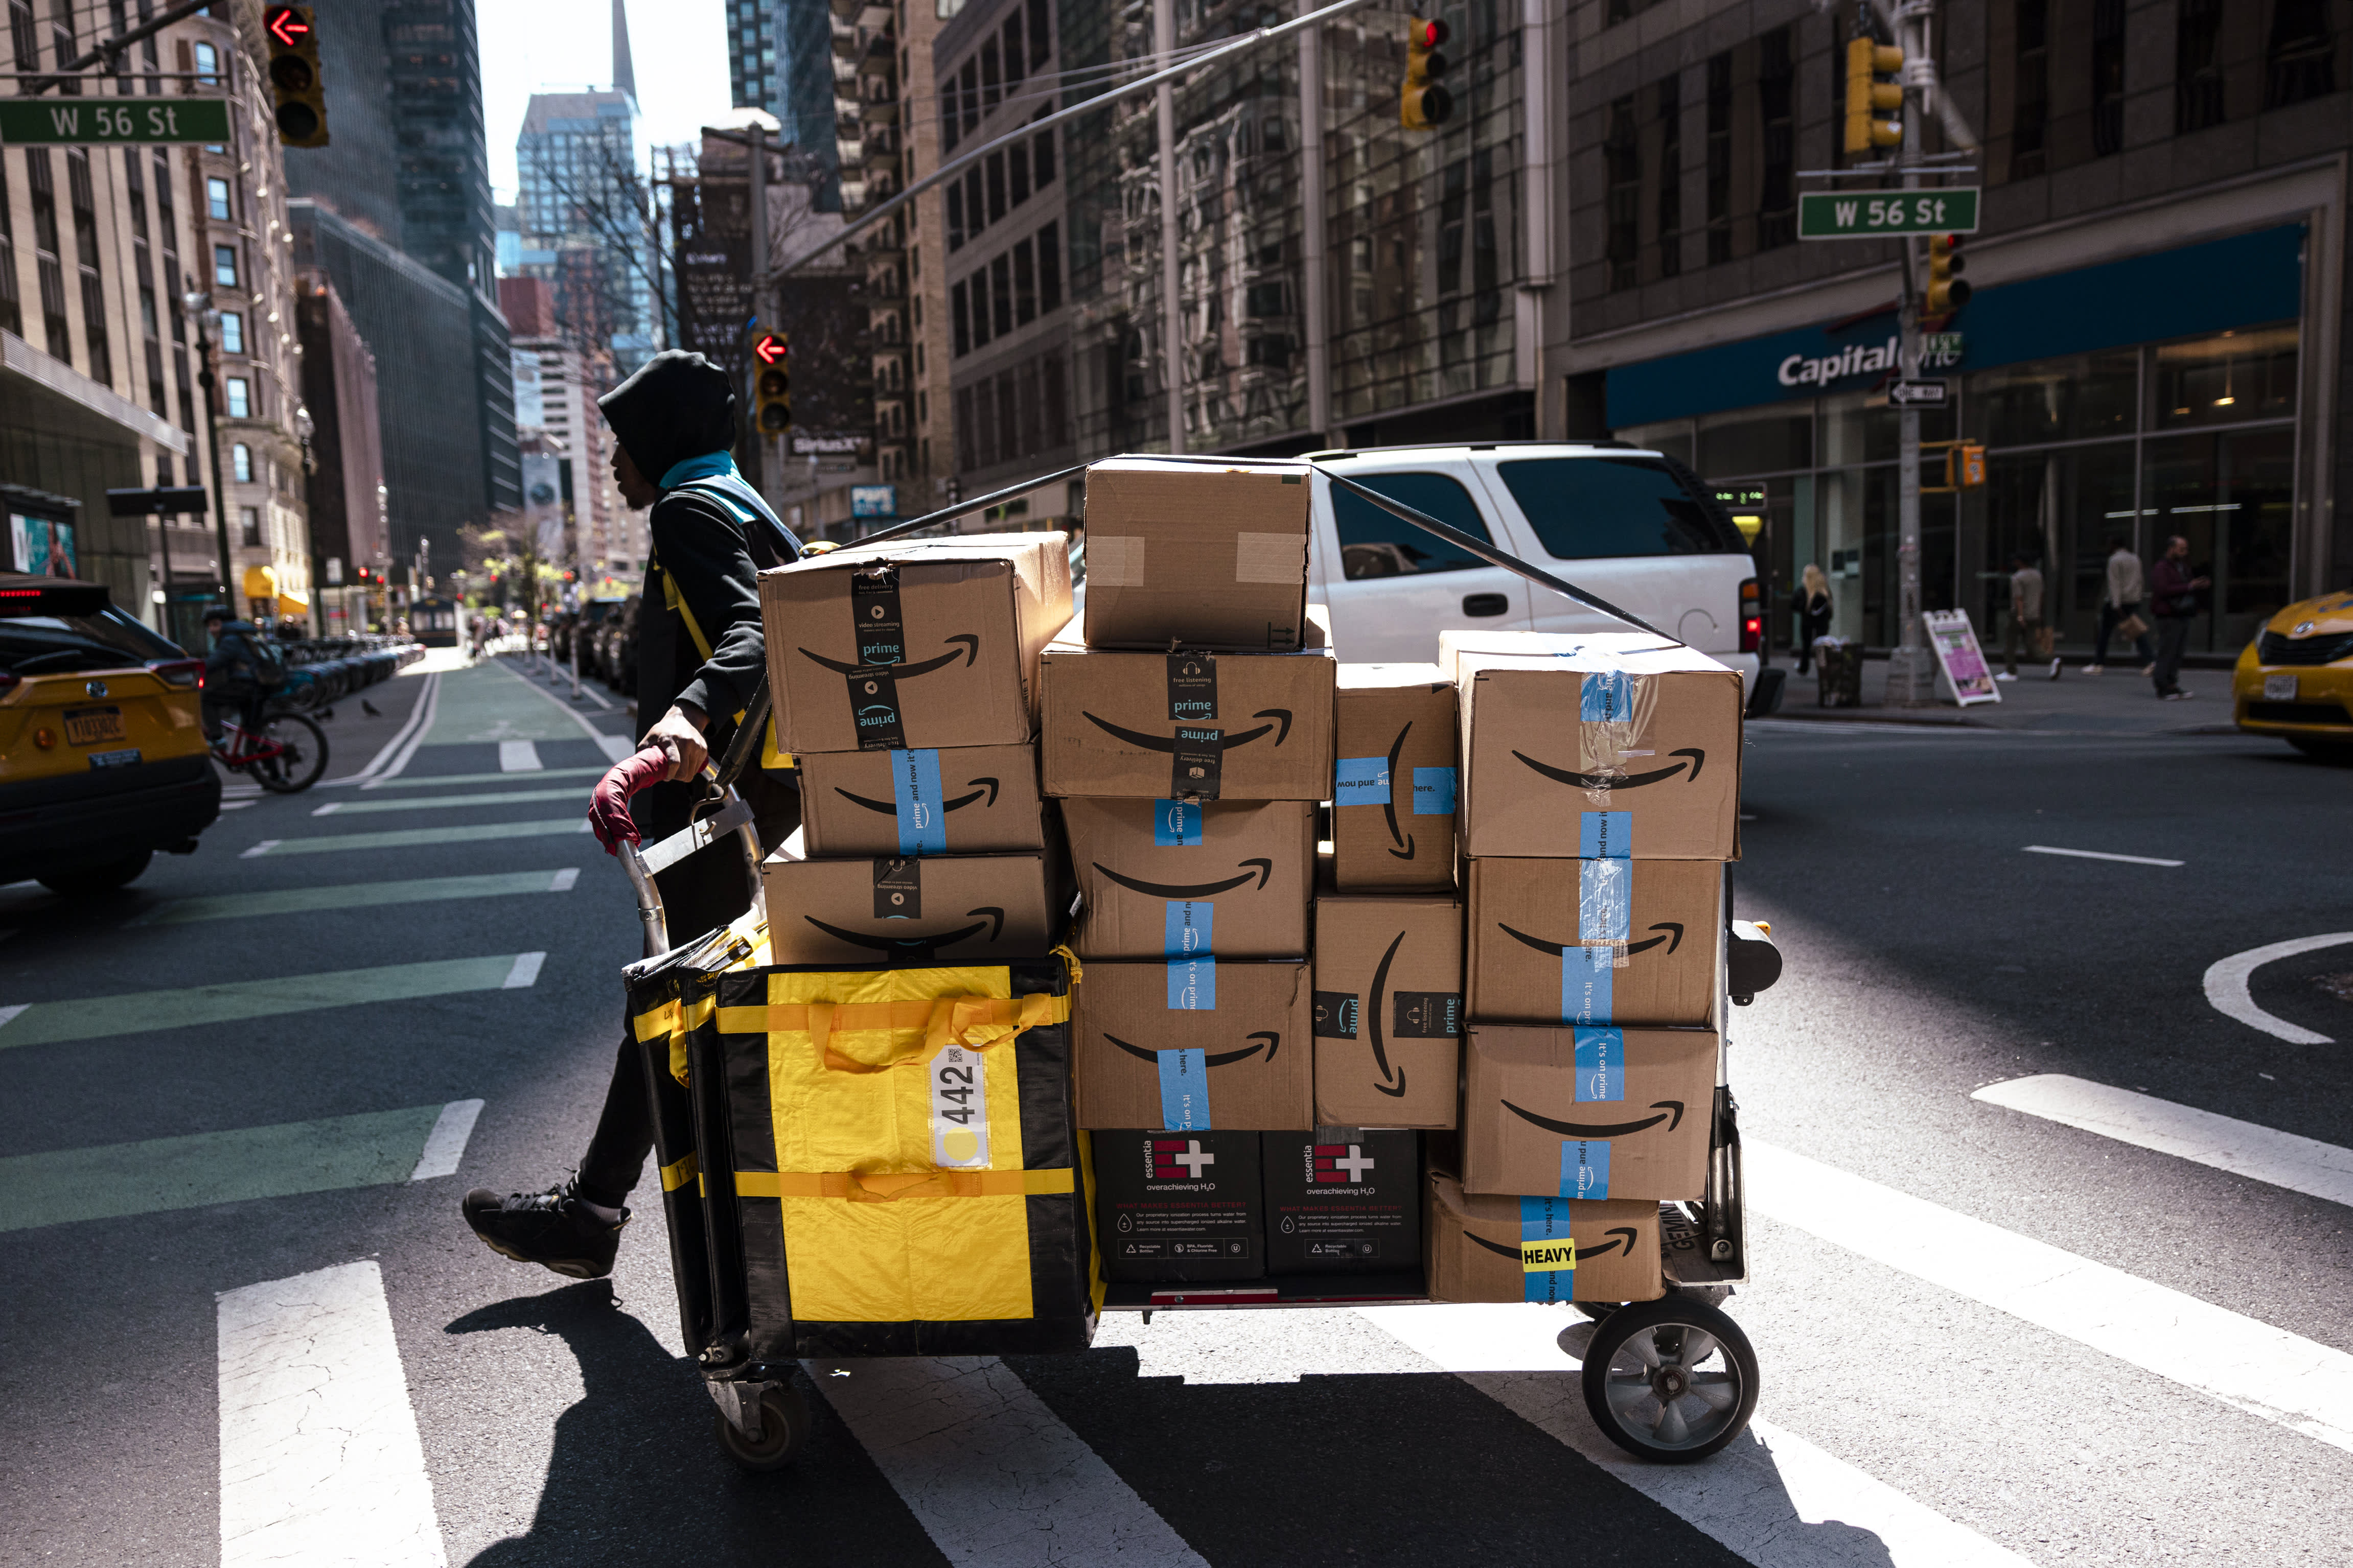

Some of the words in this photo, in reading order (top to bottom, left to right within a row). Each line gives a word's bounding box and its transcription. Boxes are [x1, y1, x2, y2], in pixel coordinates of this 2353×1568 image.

[52, 108, 78, 136] W
[96, 108, 133, 136] 56
[148, 107, 179, 136] St
[1835, 202, 1857, 227] W
[1867, 200, 1904, 225] 56
[1916, 198, 1946, 224] St
[1778, 337, 1898, 387] Capital
[864, 643, 899, 657] prime
[1175, 699, 1211, 713] prime
[1605, 693, 1613, 711] and
[860, 712, 895, 727] prime
[1182, 730, 1218, 742] prime
[1337, 779, 1356, 788] now
[1358, 780, 1375, 788] and
[910, 784, 919, 801] and
[913, 803, 924, 829] prime
[1175, 807, 1185, 832] prime
[1598, 841, 1606, 858] and
[1182, 927, 1191, 951] prime
[1190, 974, 1195, 985] on
[1585, 998, 1591, 1009] on
[1349, 999, 1358, 1034] prime
[1444, 999, 1457, 1033] prime
[1599, 1043, 1607, 1057] It's
[1179, 1055, 1187, 1076] here.
[1599, 1060, 1605, 1071] on
[1598, 1073, 1607, 1099] prime
[939, 1066, 975, 1125] 442
[1184, 1110, 1191, 1119] on
[1143, 1140, 1153, 1179] essentia
[1304, 1145, 1313, 1183] essentia
[1578, 1149, 1586, 1164] and
[1577, 1166, 1586, 1190] prime
[1544, 1198, 1553, 1212] it's
[1524, 1247, 1572, 1264] HEAVY
